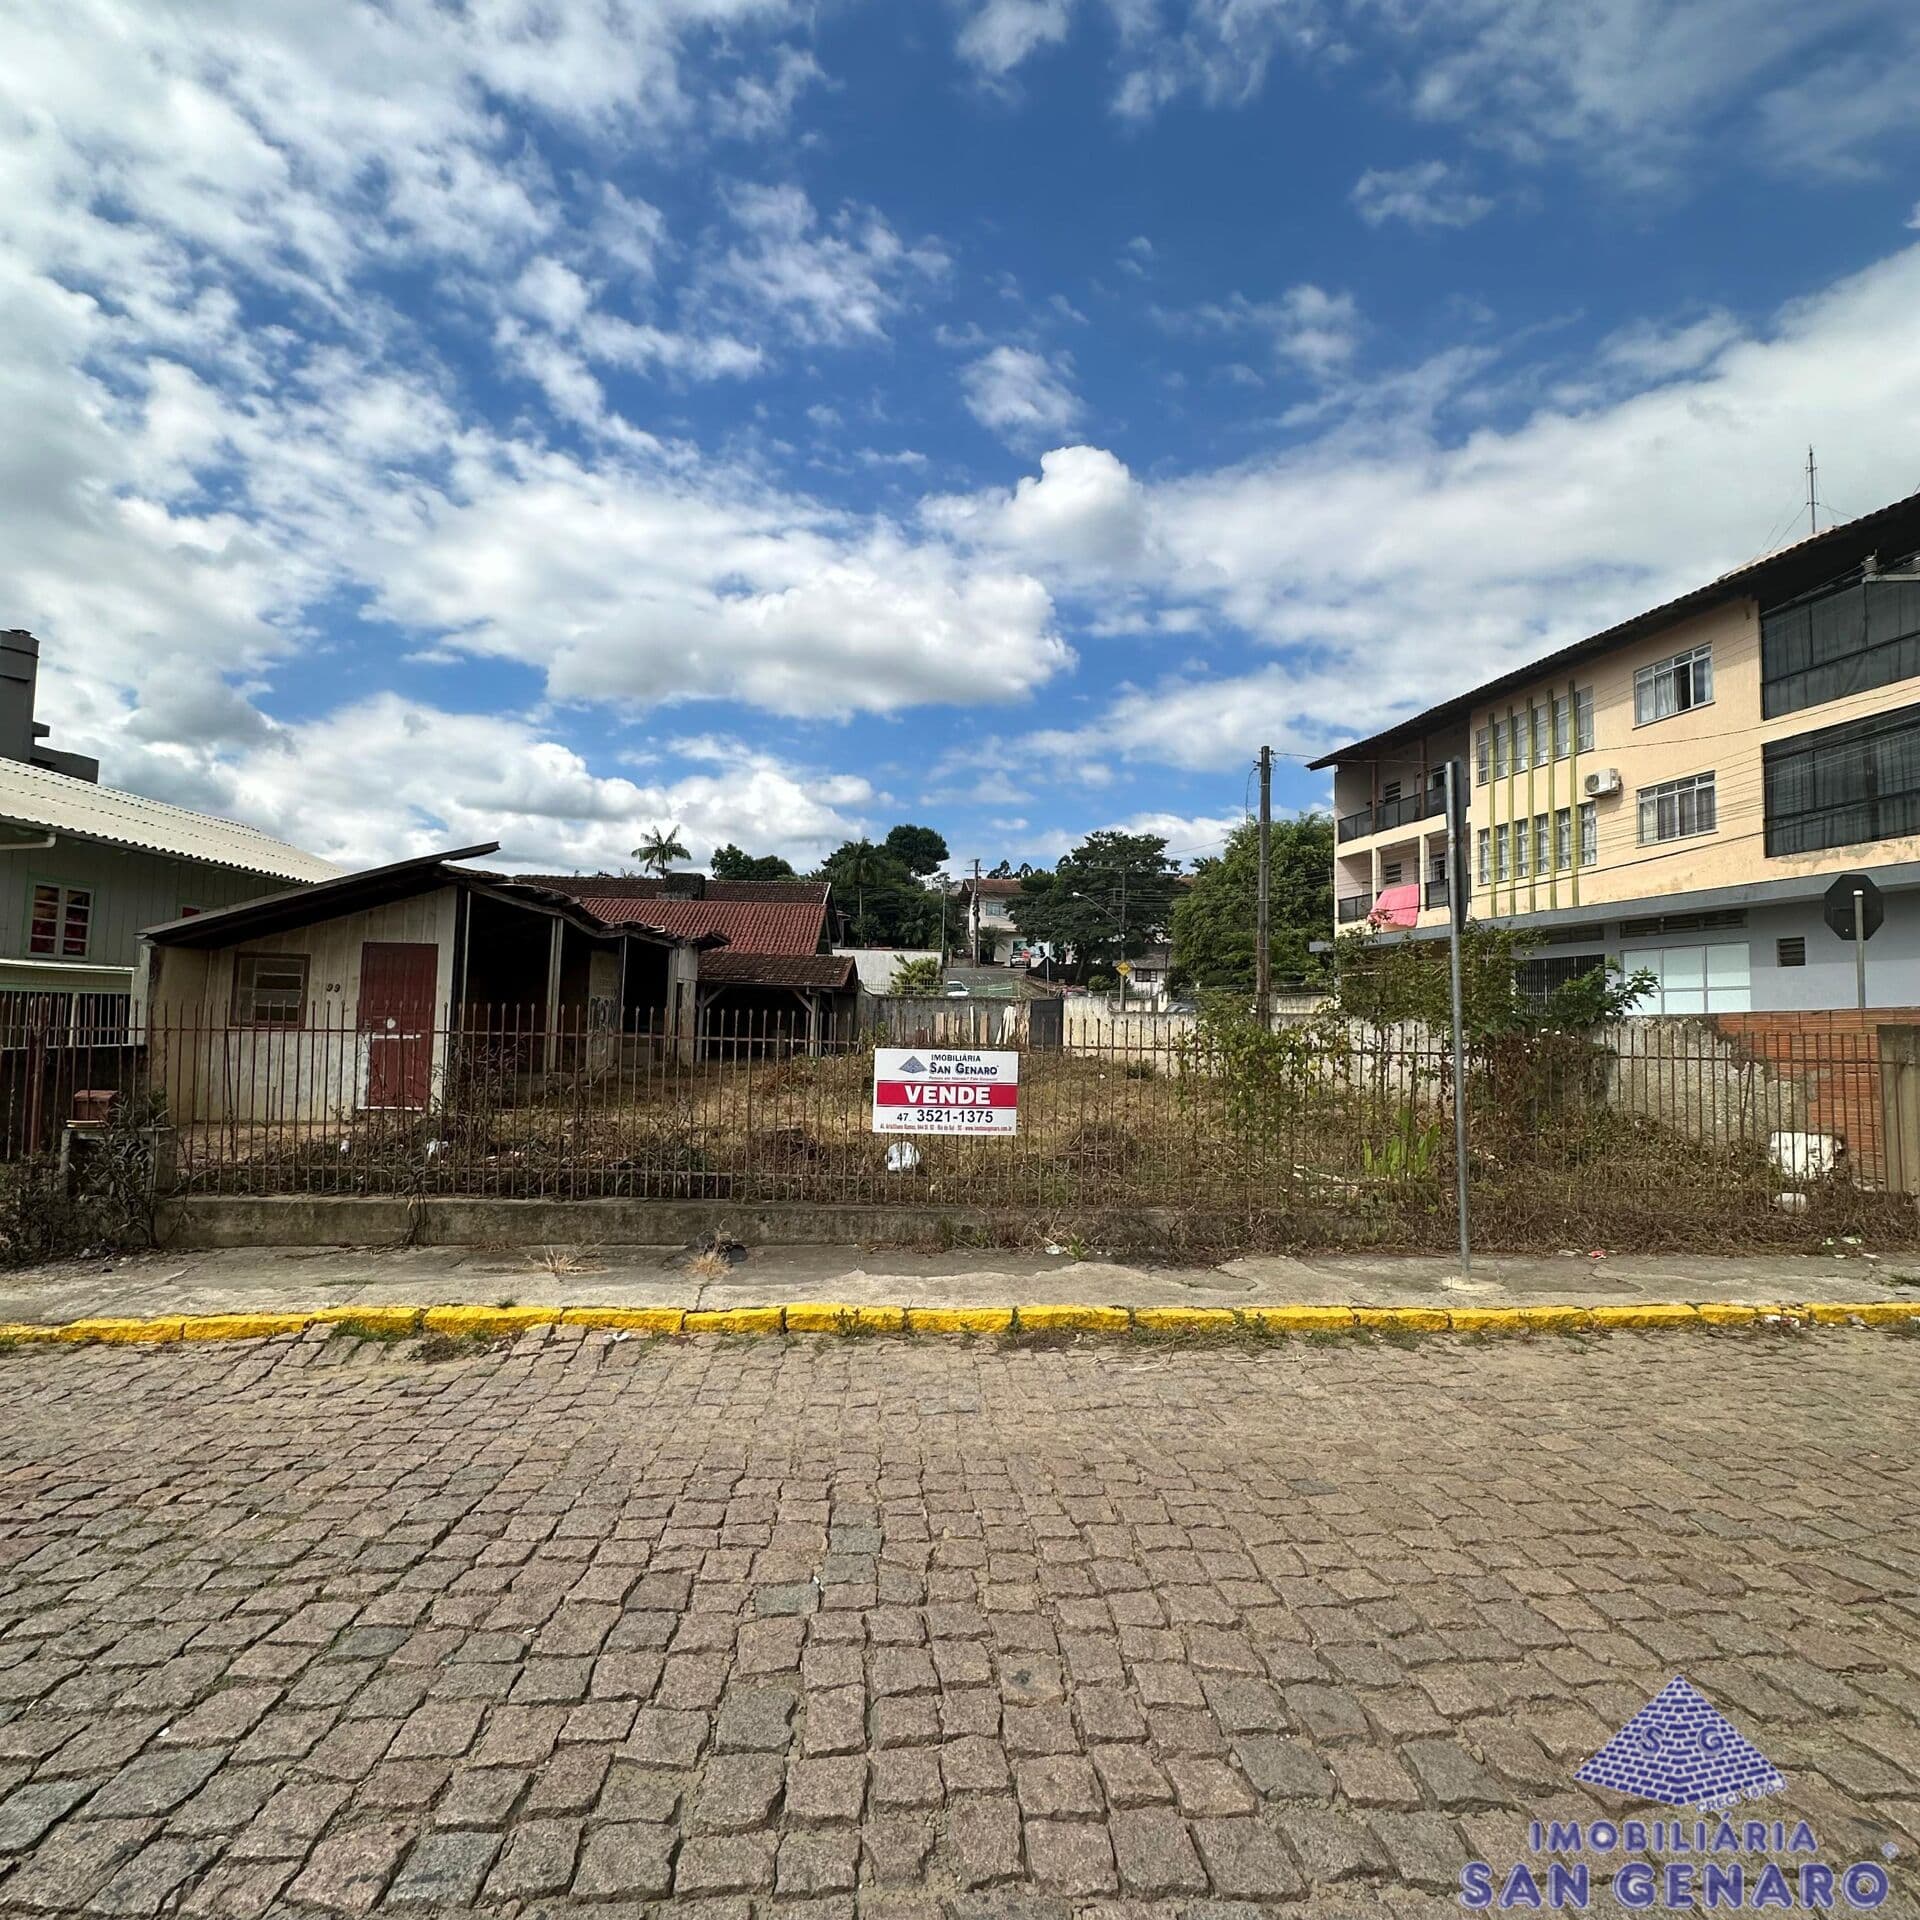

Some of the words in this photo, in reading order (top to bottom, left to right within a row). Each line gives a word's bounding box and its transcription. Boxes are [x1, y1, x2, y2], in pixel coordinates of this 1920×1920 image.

[326, 983, 341, 993] 99
[930, 1053, 981, 1062] IMOBILIÁRIA
[904, 1085, 991, 1105] VENDE
[916, 1109, 994, 1123] 3521-1375
